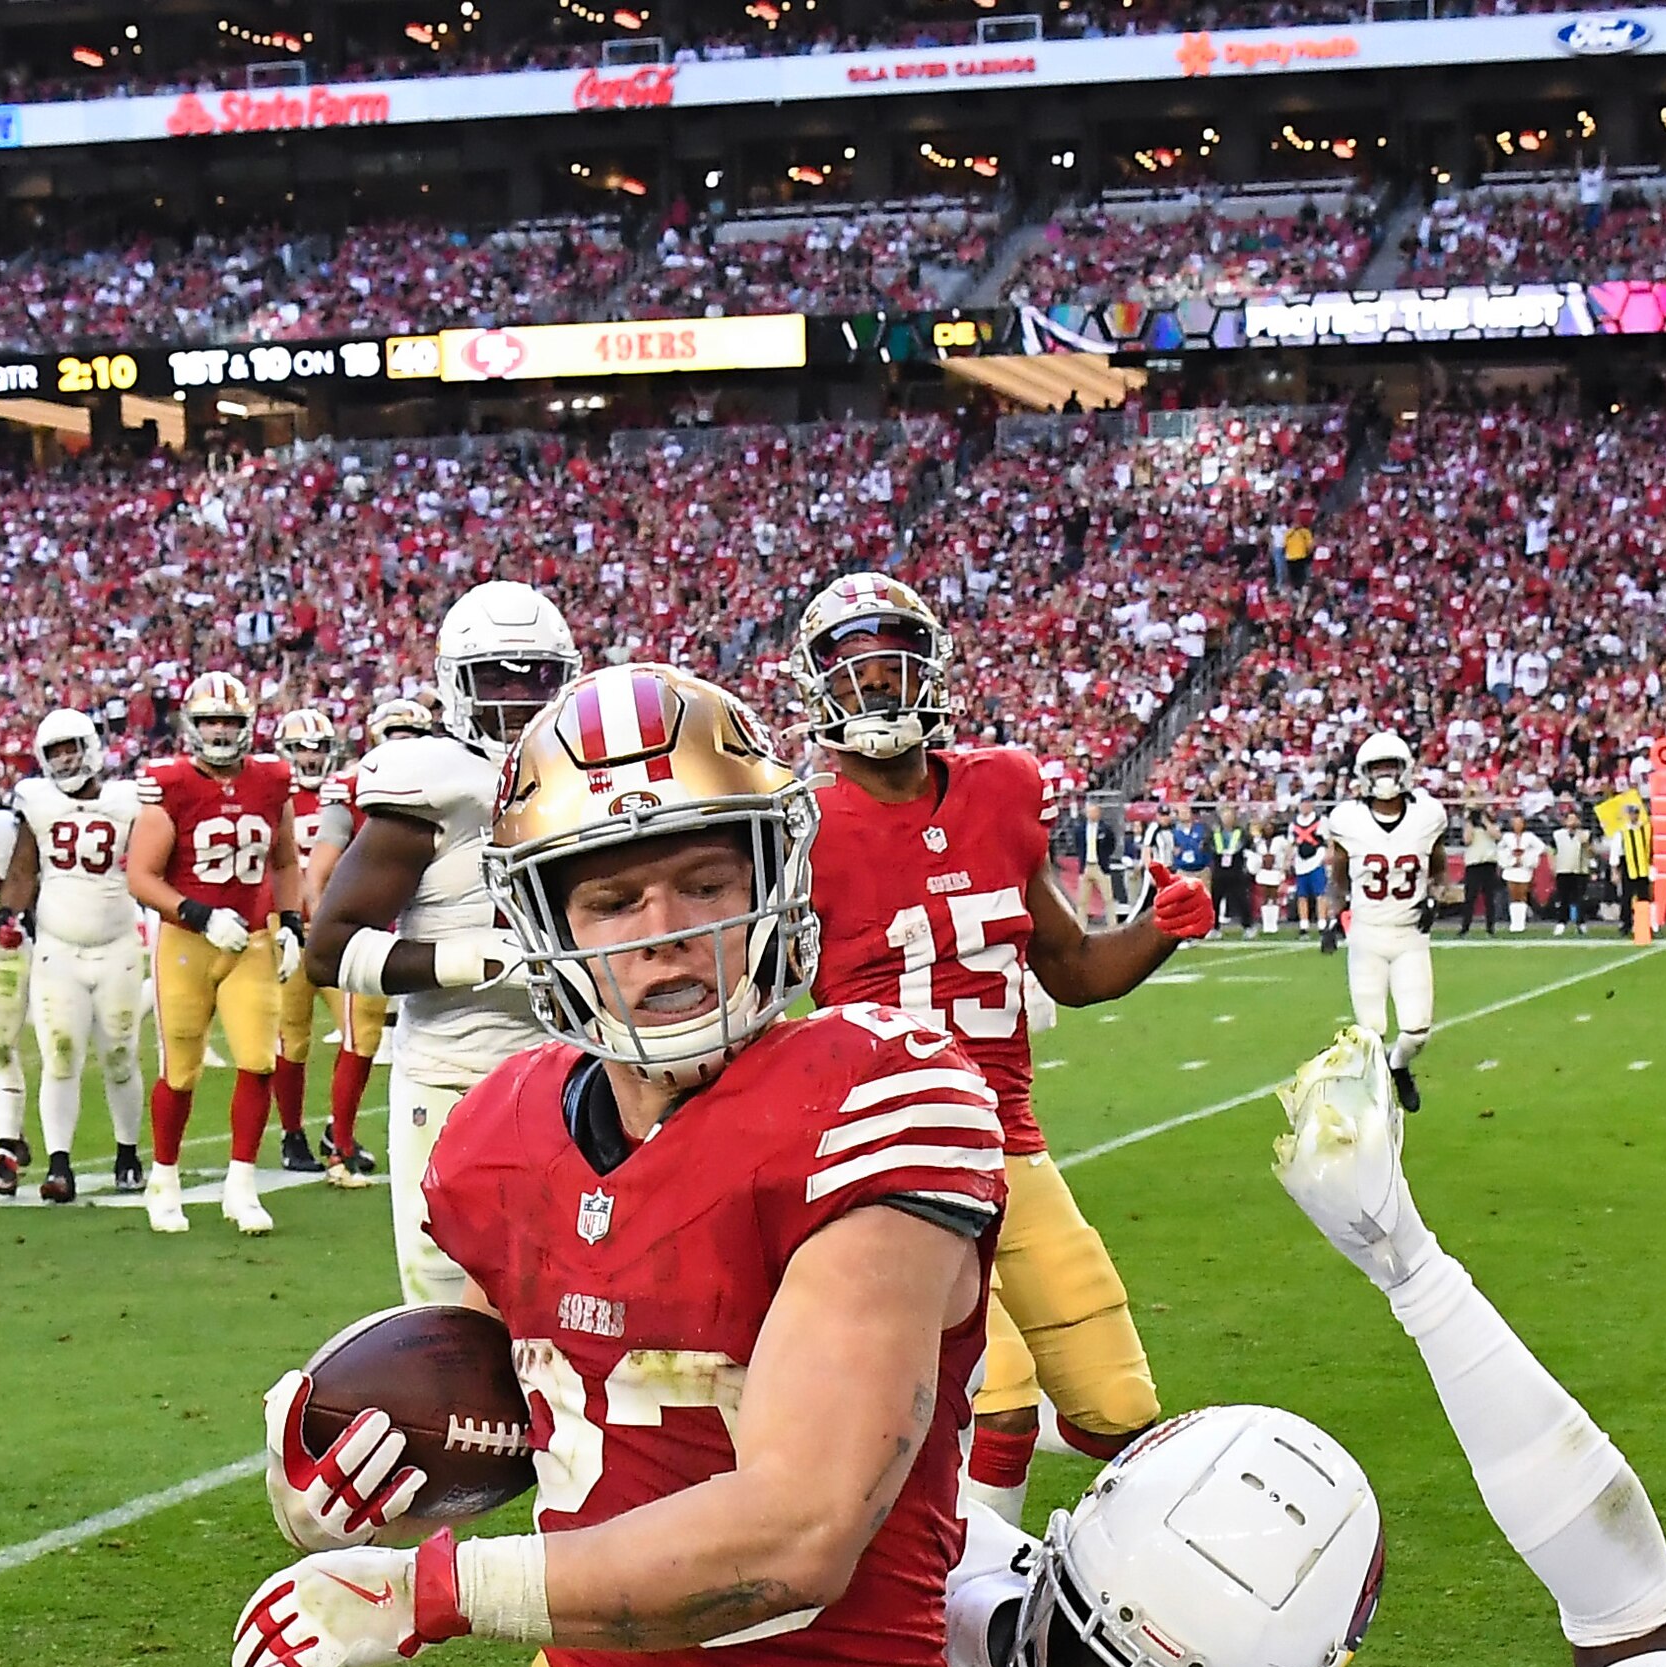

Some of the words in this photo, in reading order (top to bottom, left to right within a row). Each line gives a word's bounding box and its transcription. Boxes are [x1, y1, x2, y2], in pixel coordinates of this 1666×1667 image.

[1400, 298, 1470, 331] THE
[293, 350, 334, 376] ON
[594, 330, 697, 363] 49ERS
[58, 355, 137, 391] 2:10
[51, 820, 117, 875] 93
[192, 813, 272, 885] 68
[1362, 853, 1421, 901] 33
[885, 886, 1031, 1038] 15
[556, 1292, 627, 1339] 49ERS
